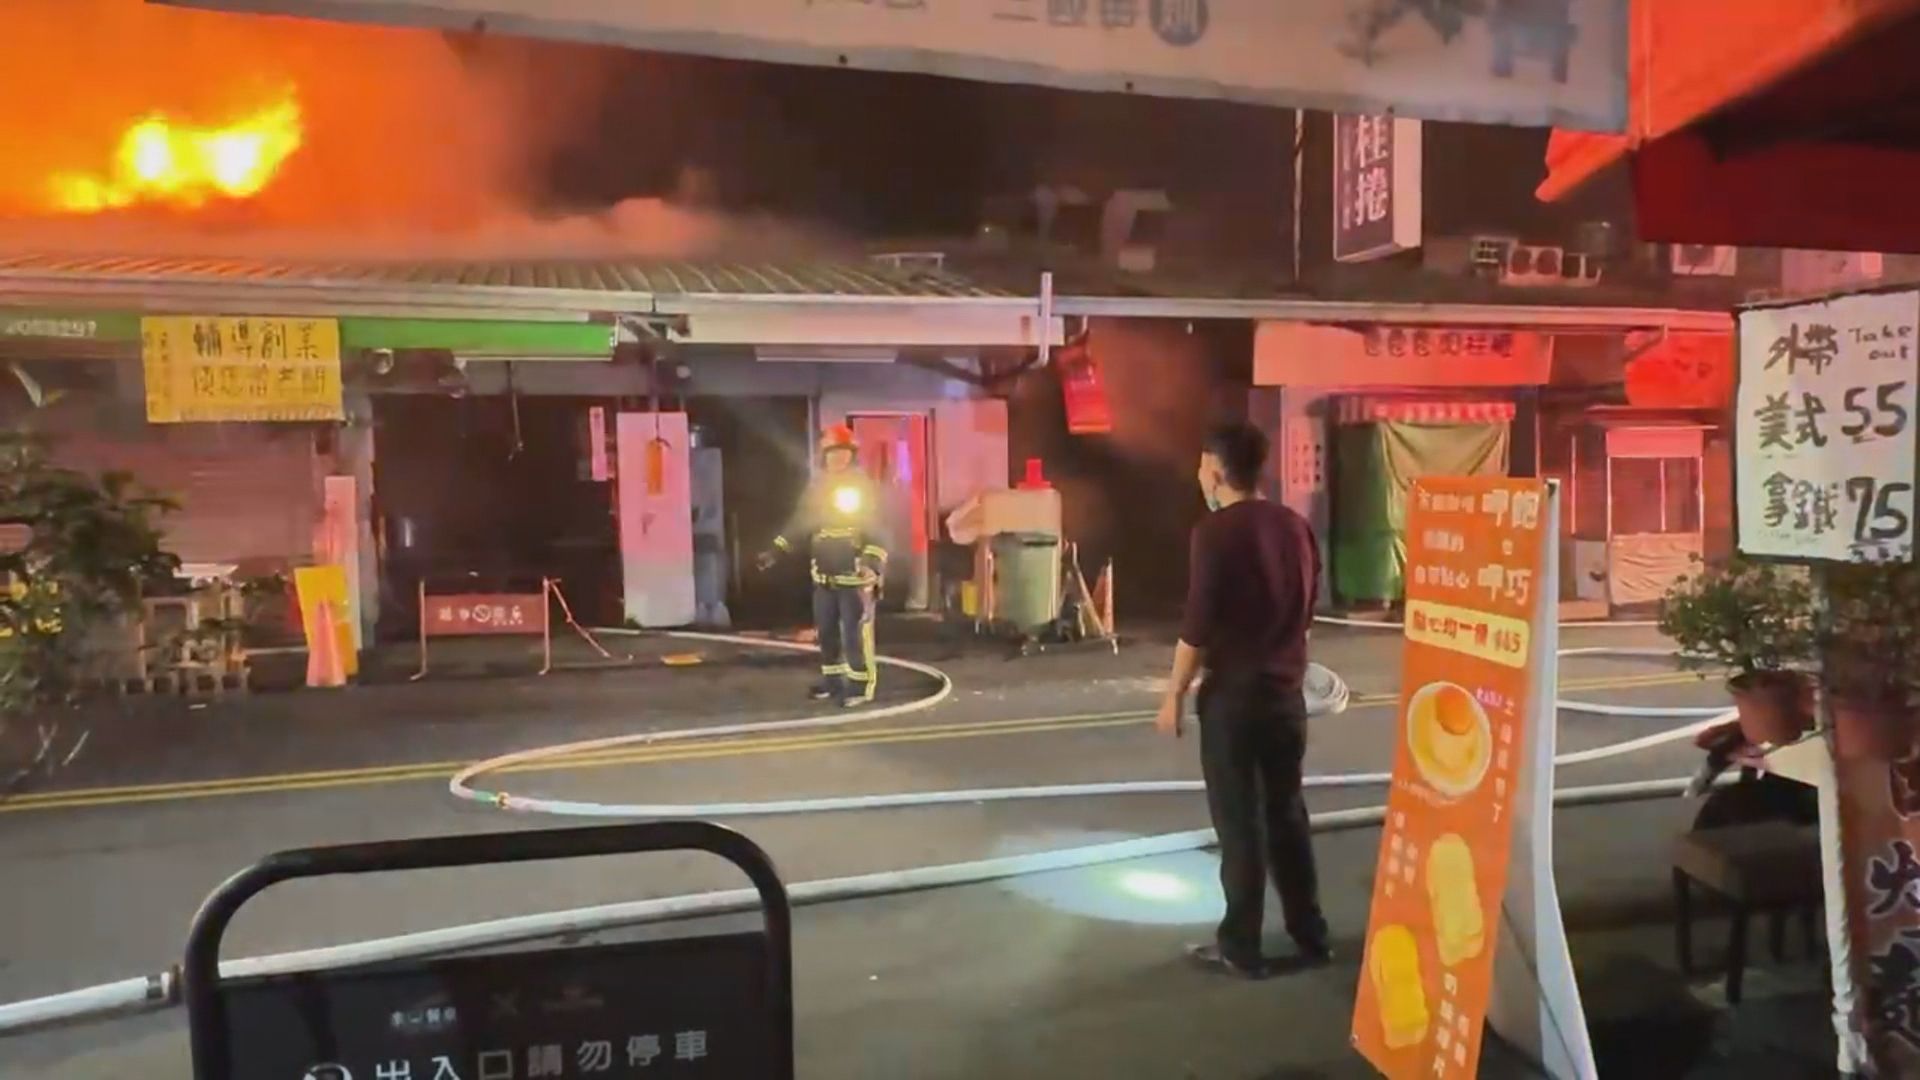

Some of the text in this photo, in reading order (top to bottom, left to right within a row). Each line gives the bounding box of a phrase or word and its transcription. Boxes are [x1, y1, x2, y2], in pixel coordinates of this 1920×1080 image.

[1763, 323, 1839, 375] 外帶
[1847, 324, 1912, 343] Take
[1868, 346, 1910, 360] out
[1753, 381, 1908, 450] 美式 55
[1762, 471, 1911, 541] 拿鐵 75
[376, 1030, 709, 1080] 出入口請勿停車
